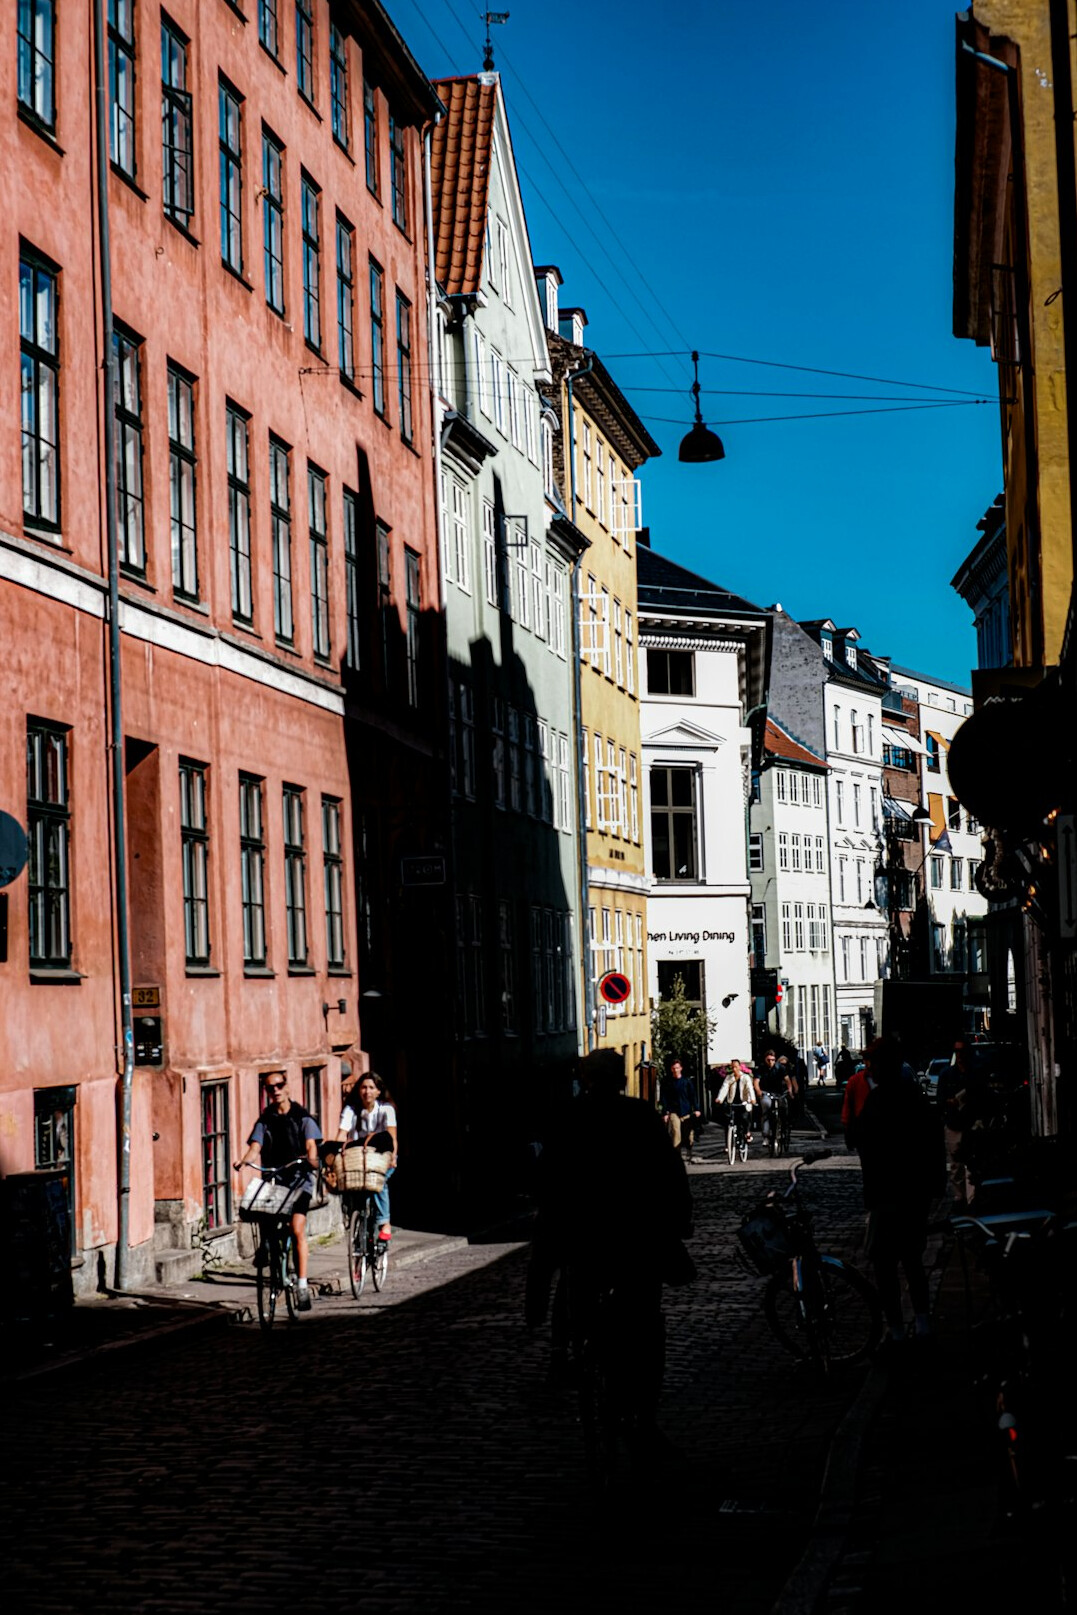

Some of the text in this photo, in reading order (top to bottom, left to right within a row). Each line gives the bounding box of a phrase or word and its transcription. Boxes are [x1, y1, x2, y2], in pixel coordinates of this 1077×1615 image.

[669, 930, 700, 944] Living
[702, 930, 735, 944] Dining
[138, 990, 154, 1003] 32
